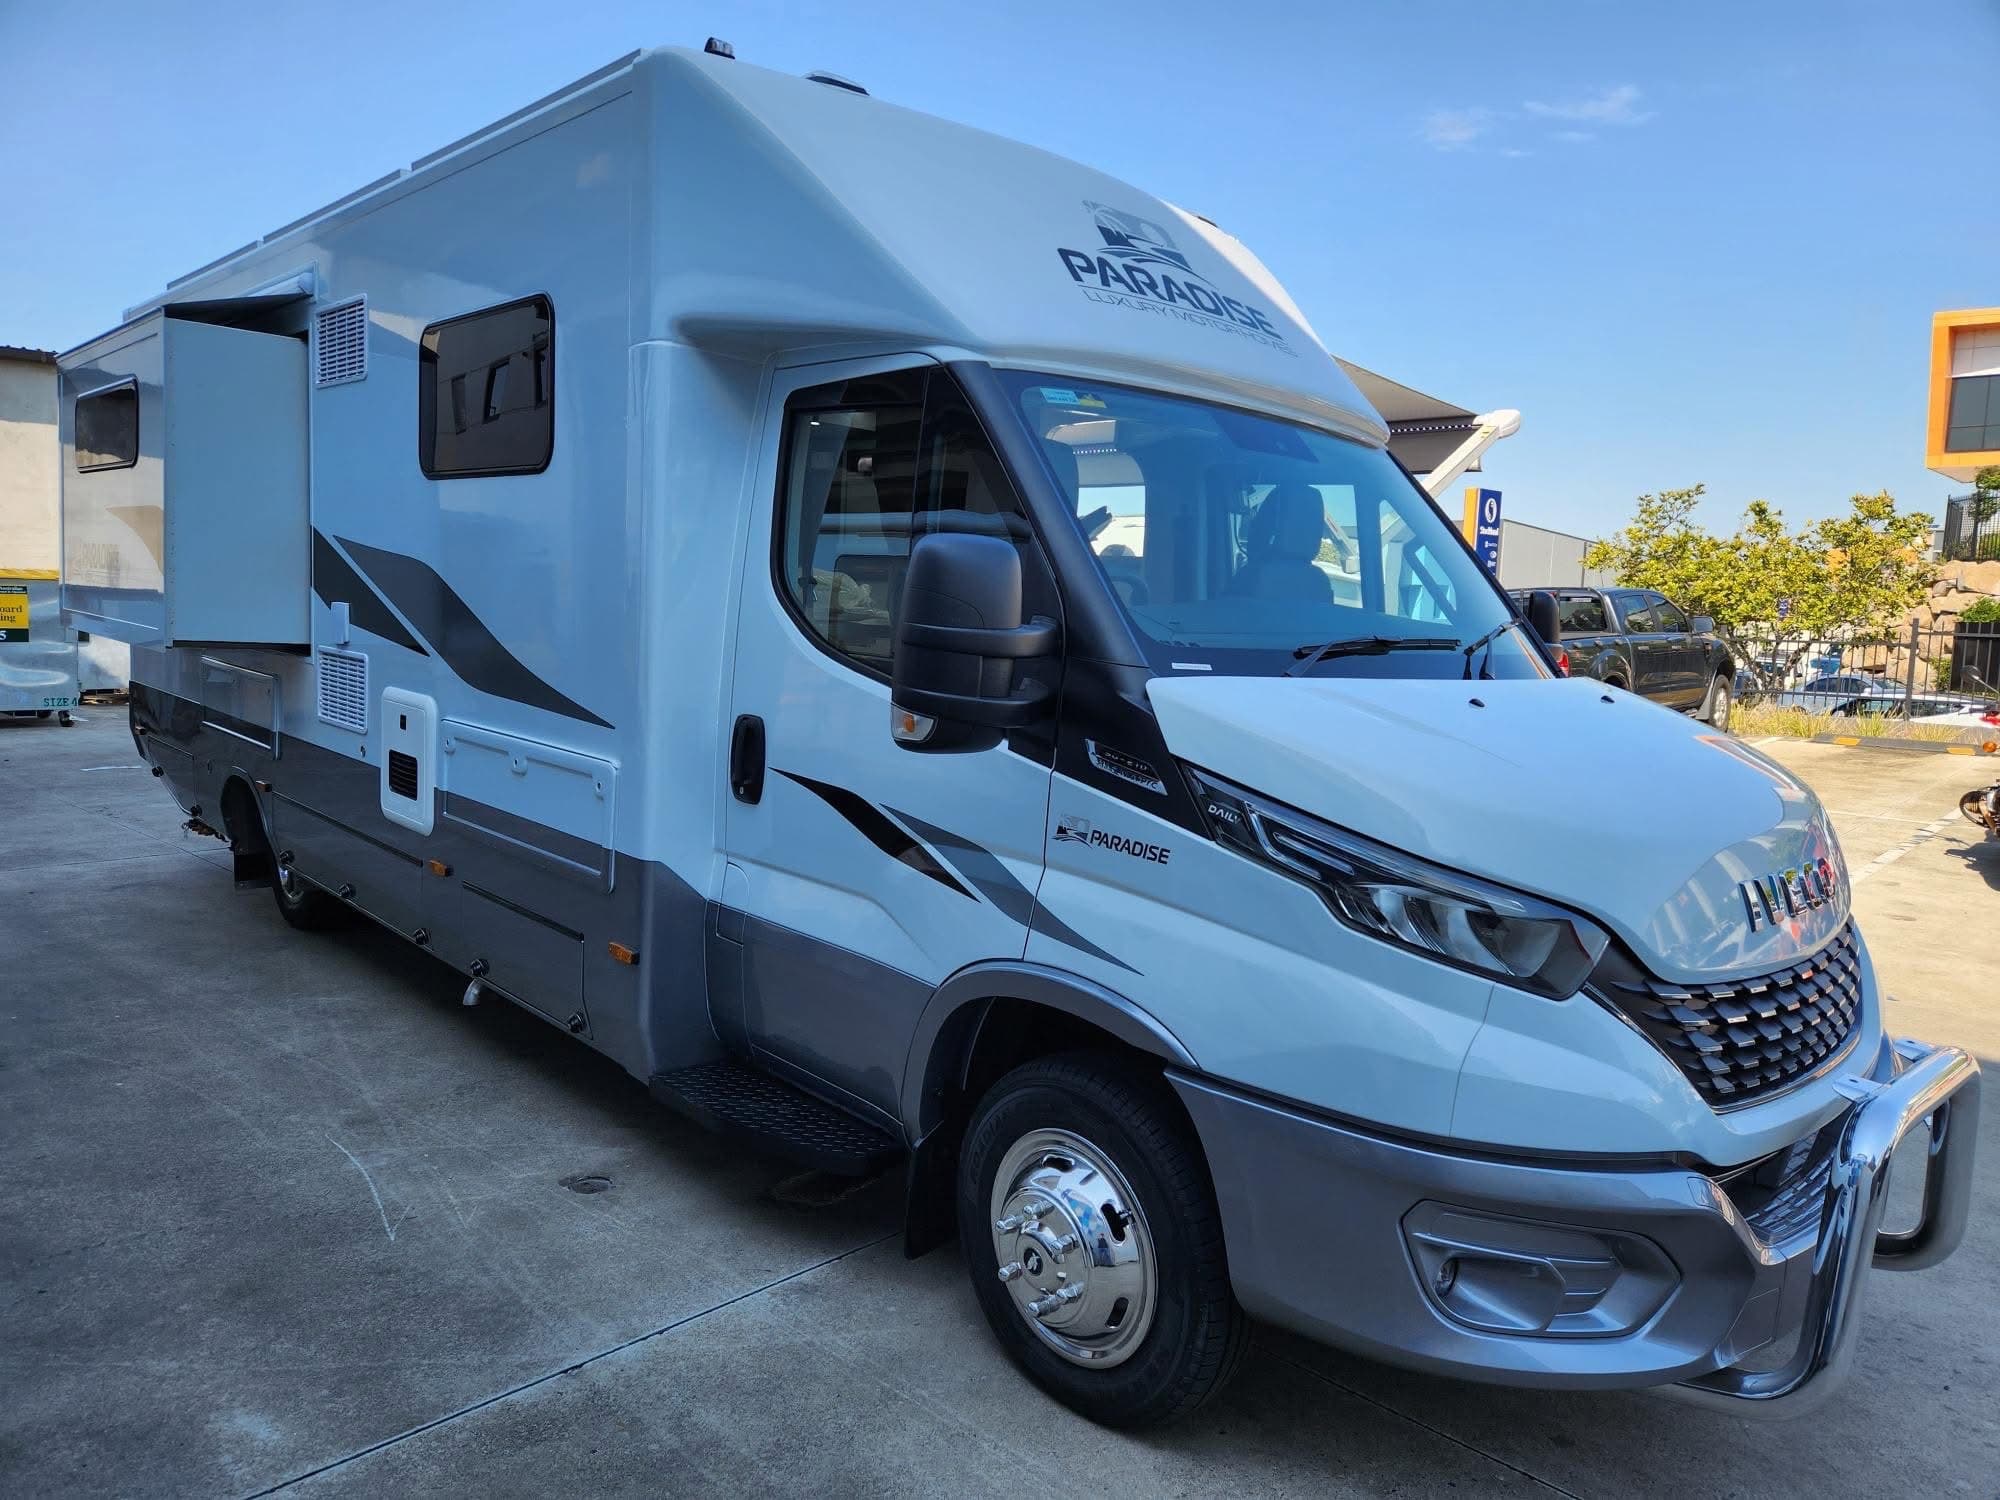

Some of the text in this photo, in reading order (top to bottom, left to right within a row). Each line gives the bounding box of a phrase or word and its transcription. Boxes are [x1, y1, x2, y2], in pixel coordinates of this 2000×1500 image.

[1057, 248, 1283, 340] PARADISE
[1083, 289, 1167, 316] LUXURY
[43, 697, 70, 707] SIZE
[1208, 804, 1241, 824] DAILY
[1090, 829, 1171, 865] PARADISE
[1738, 857, 1836, 934] IVECO
